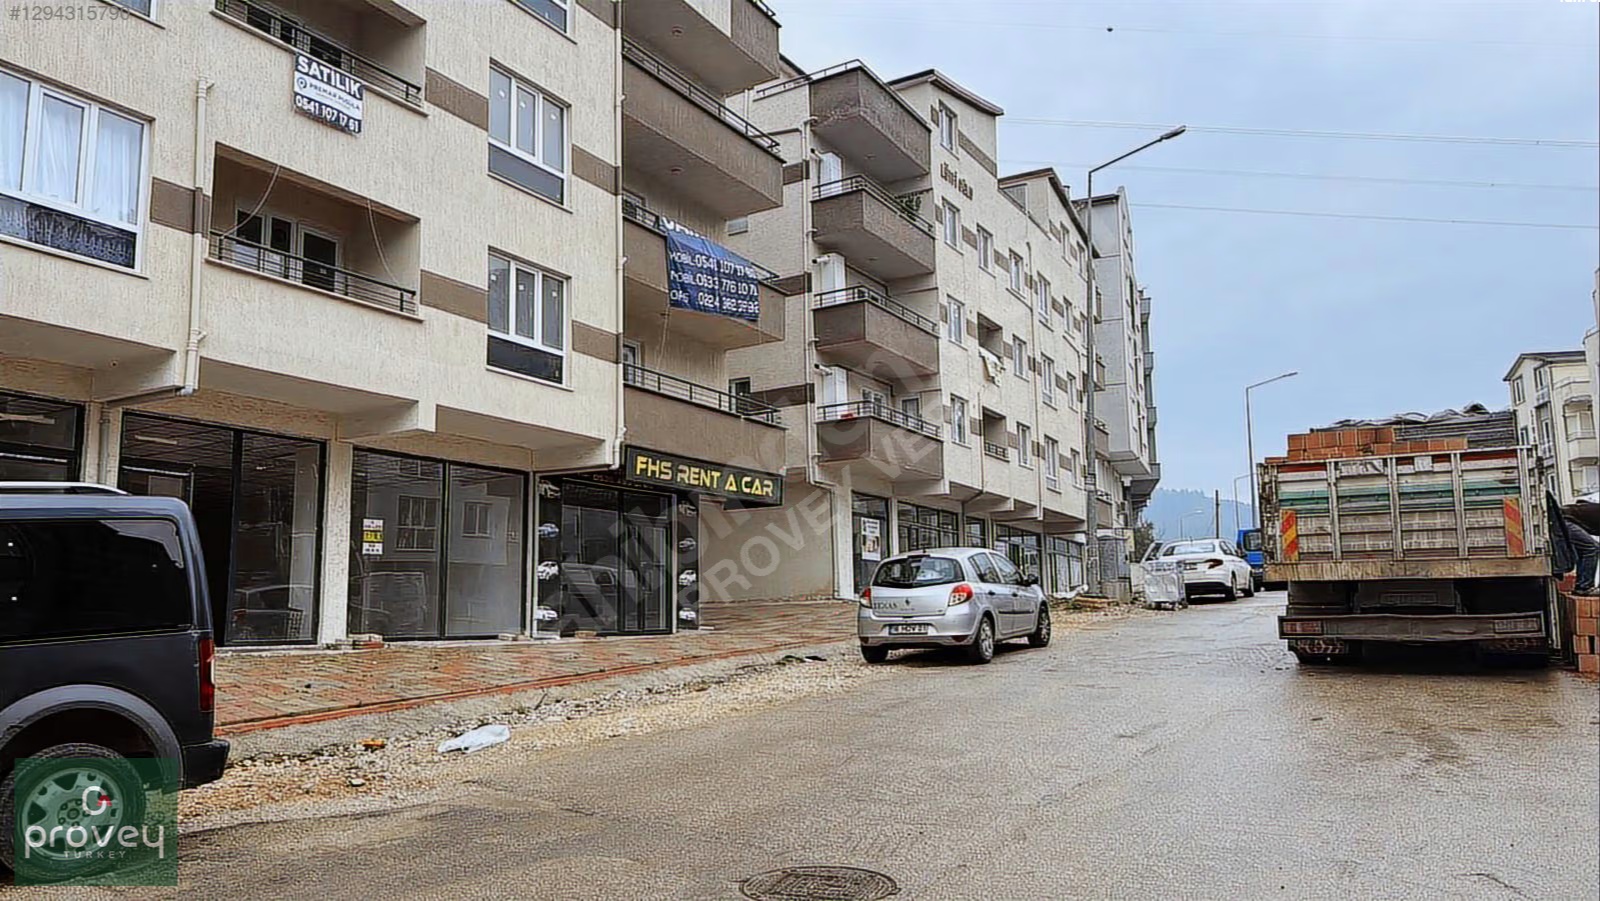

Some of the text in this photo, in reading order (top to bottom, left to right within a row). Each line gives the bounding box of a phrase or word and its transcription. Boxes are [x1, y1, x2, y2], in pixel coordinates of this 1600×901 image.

[635, 455, 673, 481] FHS
[677, 464, 722, 489] RENT
[724, 473, 739, 492] A
[741, 476, 774, 497] CAR
